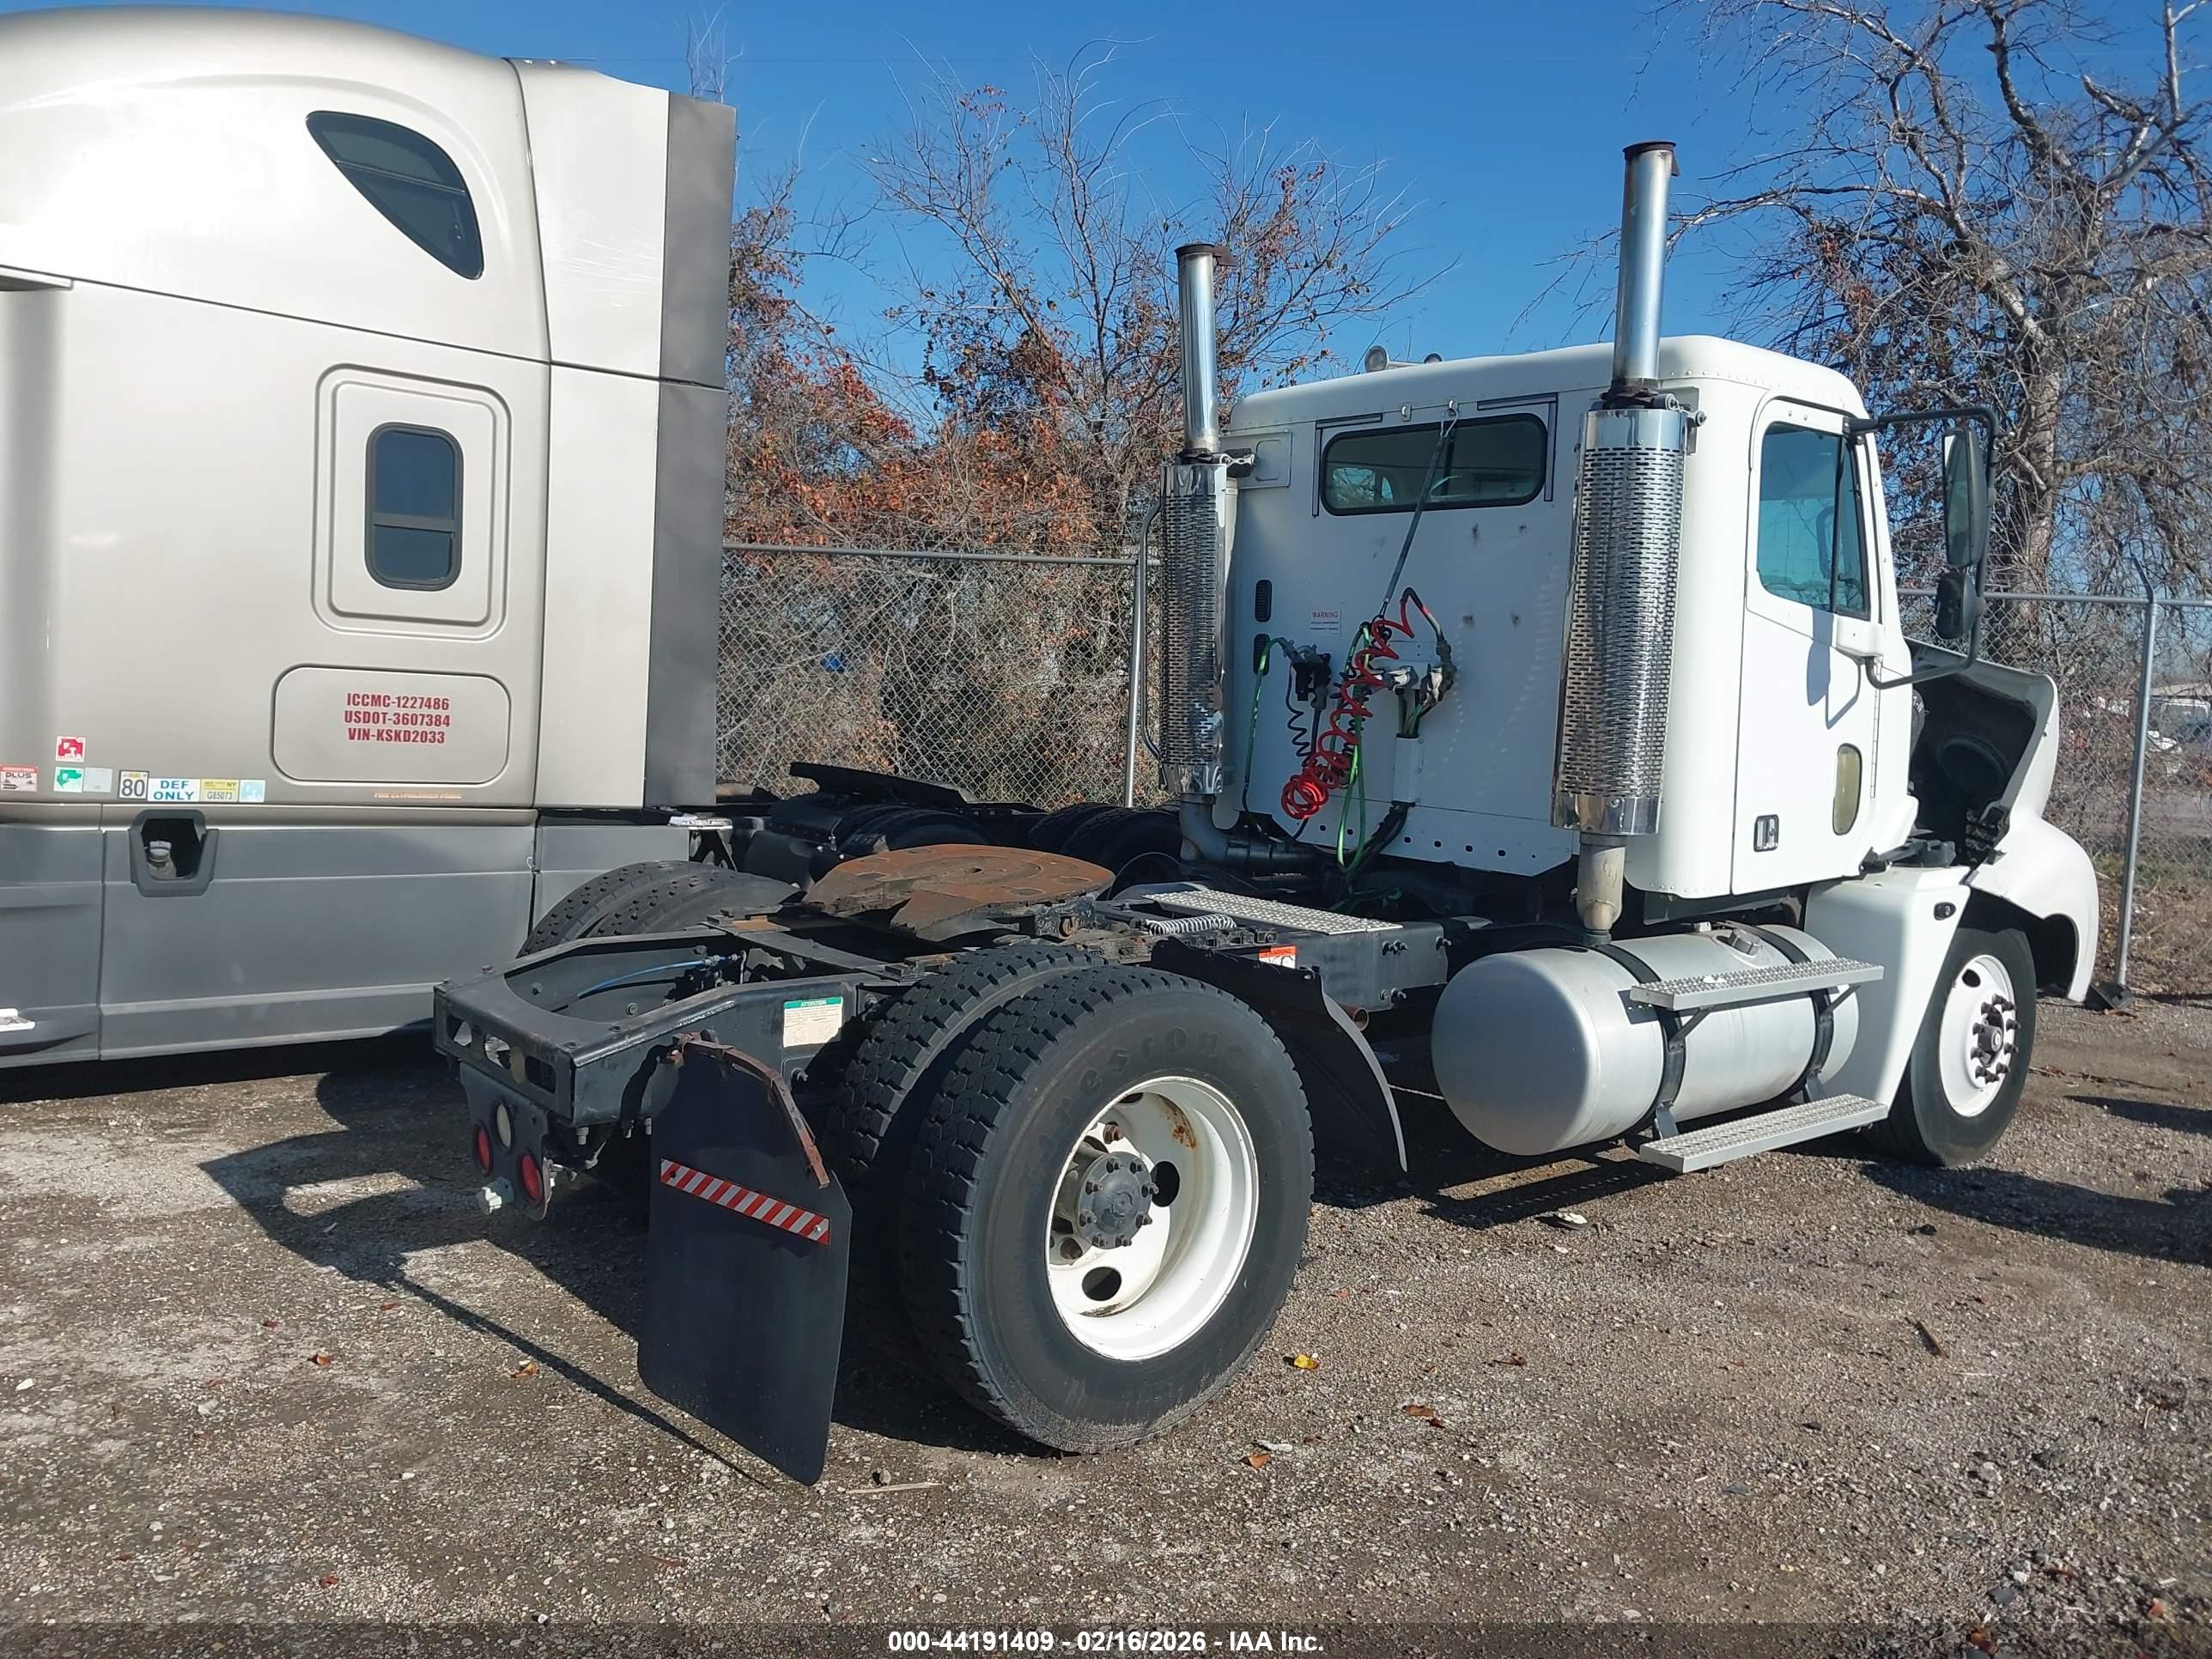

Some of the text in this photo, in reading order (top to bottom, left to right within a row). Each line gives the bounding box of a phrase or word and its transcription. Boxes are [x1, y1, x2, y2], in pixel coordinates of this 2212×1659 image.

[347, 693, 450, 710] ICCMC-1227486
[344, 710, 450, 727] USDOT-3607384
[348, 727, 445, 744] VIN-KSKD2033
[121, 779, 145, 797] 80
[161, 780, 189, 789] DEF
[153, 791, 194, 800] ONLY
